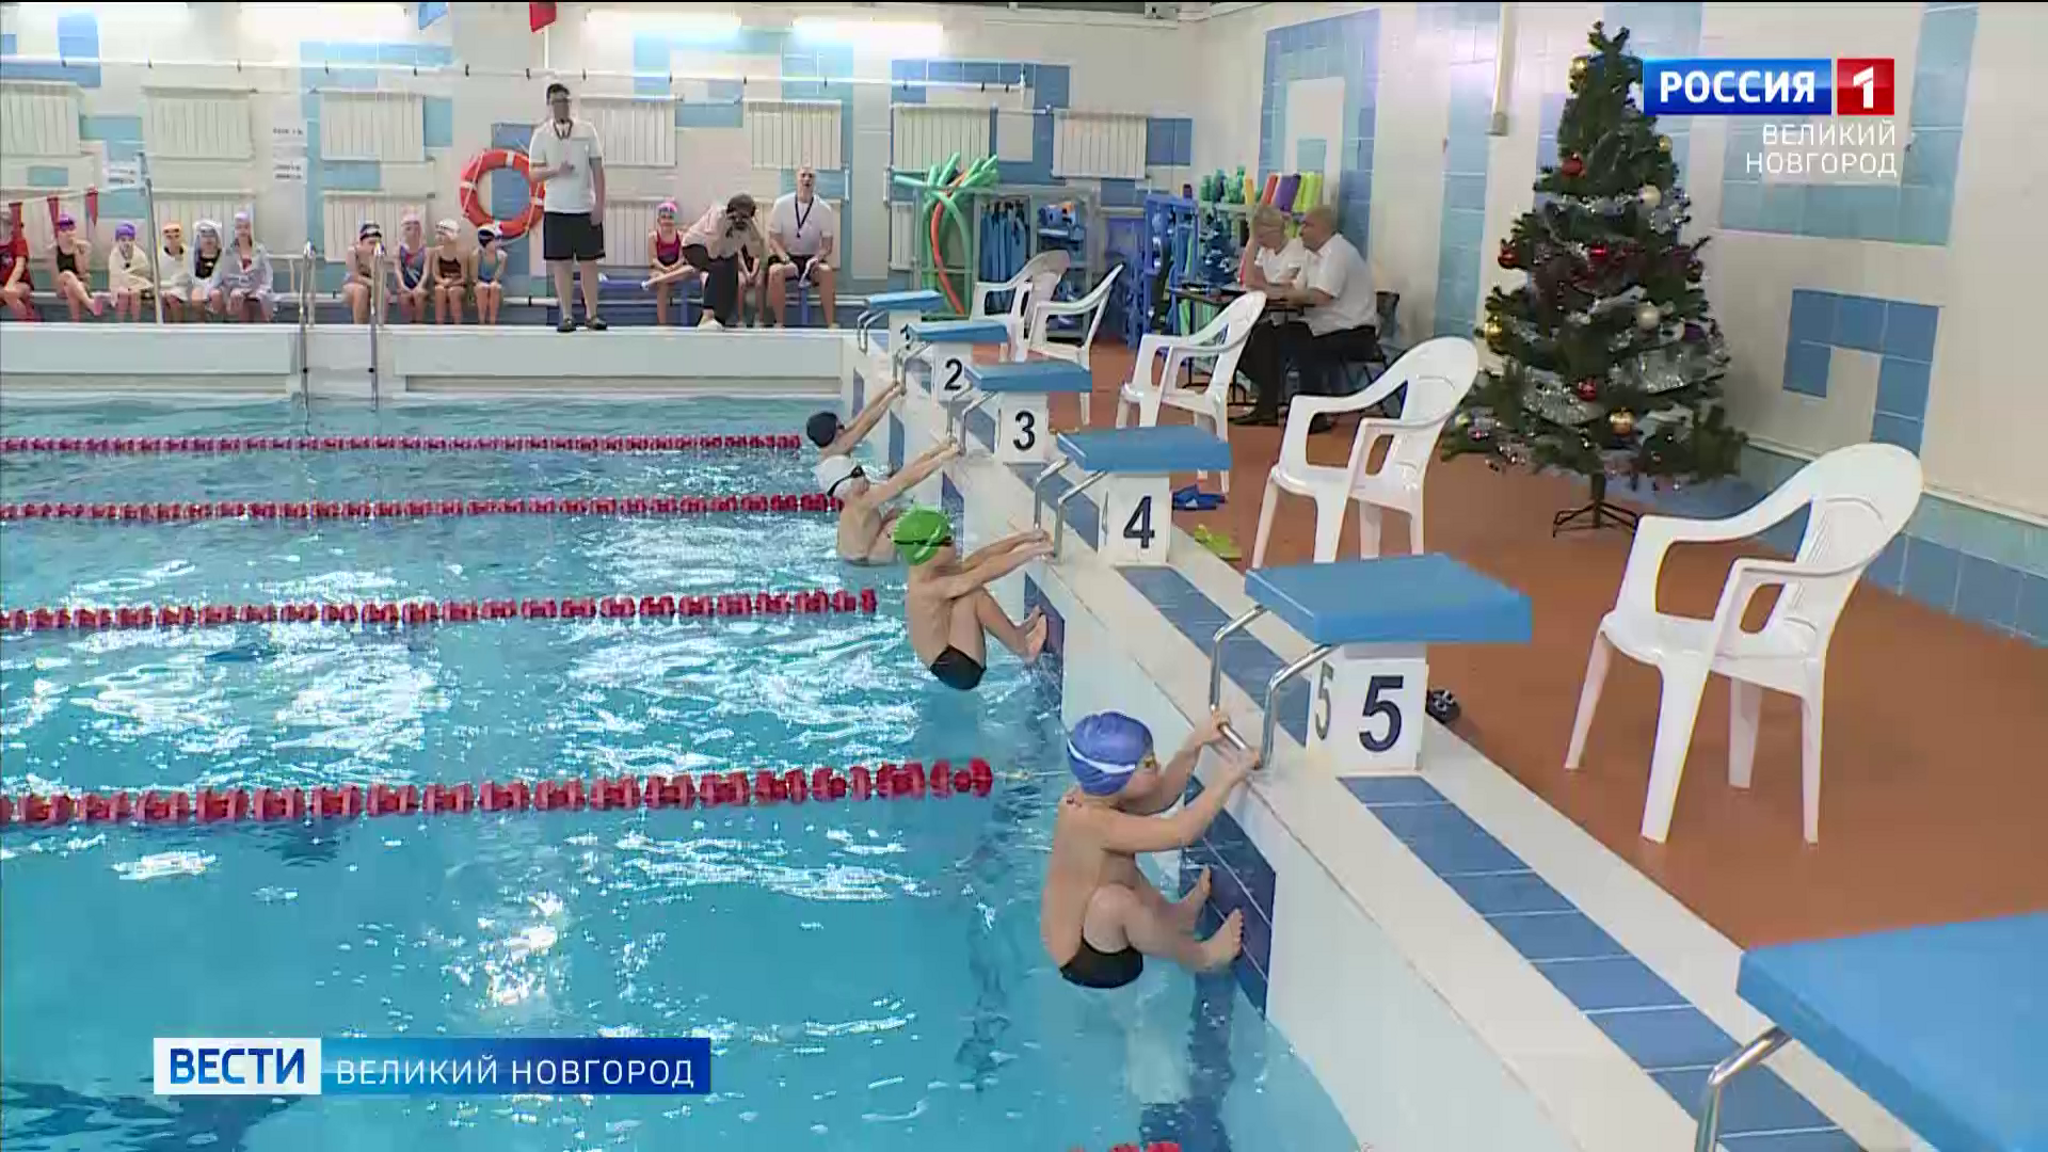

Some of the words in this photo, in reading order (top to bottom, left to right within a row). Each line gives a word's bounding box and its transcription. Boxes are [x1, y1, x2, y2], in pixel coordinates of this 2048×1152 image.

[943, 358, 963, 391] 2
[1013, 410, 1035, 451] 3
[1123, 495, 1155, 549] 4
[1315, 659, 1334, 741] 5
[1358, 675, 1404, 752] 5
